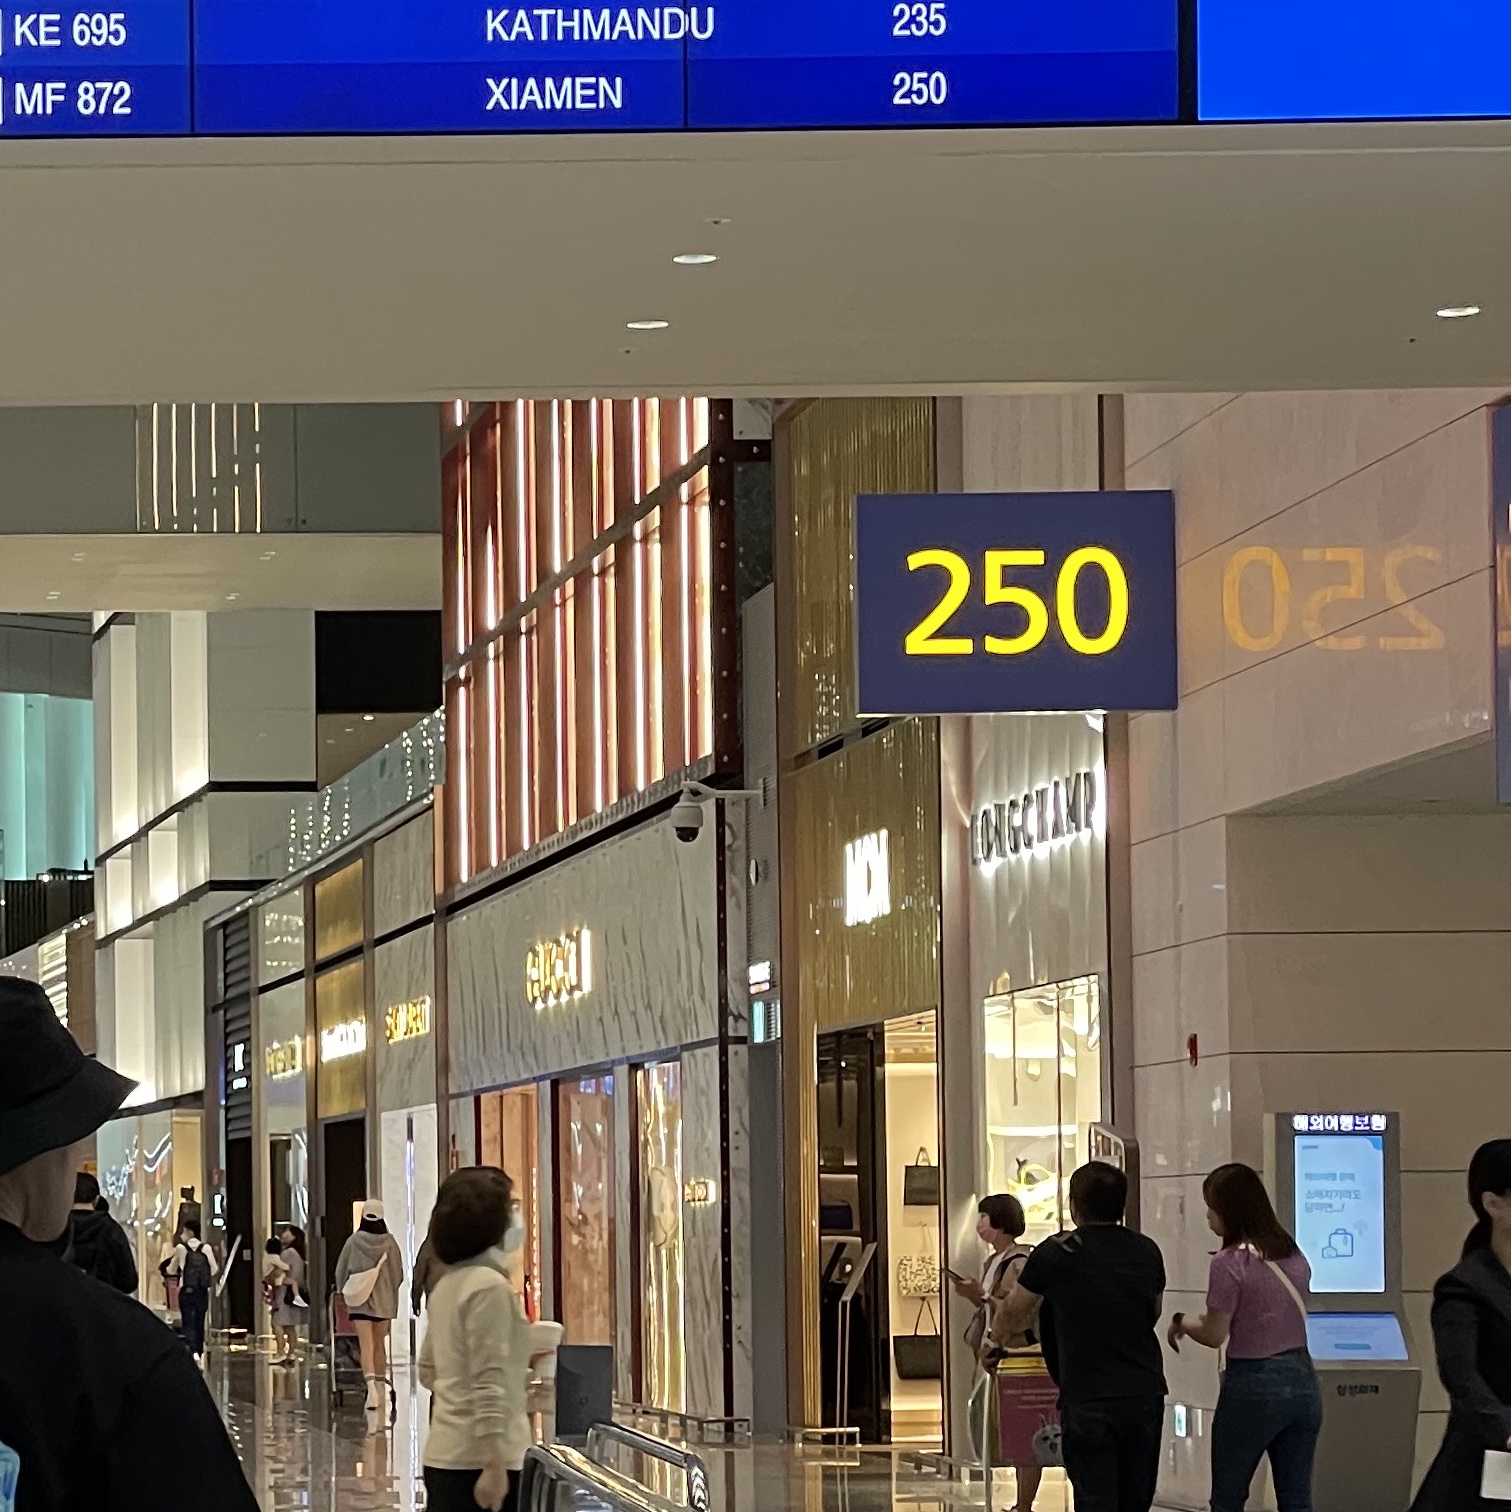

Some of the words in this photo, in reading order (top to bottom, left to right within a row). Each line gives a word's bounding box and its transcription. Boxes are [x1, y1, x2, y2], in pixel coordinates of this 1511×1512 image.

[14, 13, 61, 47] KE
[72, 12, 127, 47] 695
[486, 5, 714, 41] KATHMANDU
[892, 2, 947, 37] 235
[15, 82, 67, 115] MF
[76, 80, 132, 115] 872
[485, 76, 623, 111] XIAMEN
[892, 70, 947, 105] 250
[904, 546, 1129, 655] 250
[971, 771, 1097, 866] LONGCHAMP
[1292, 1113, 1387, 1132] 해외여행보험
